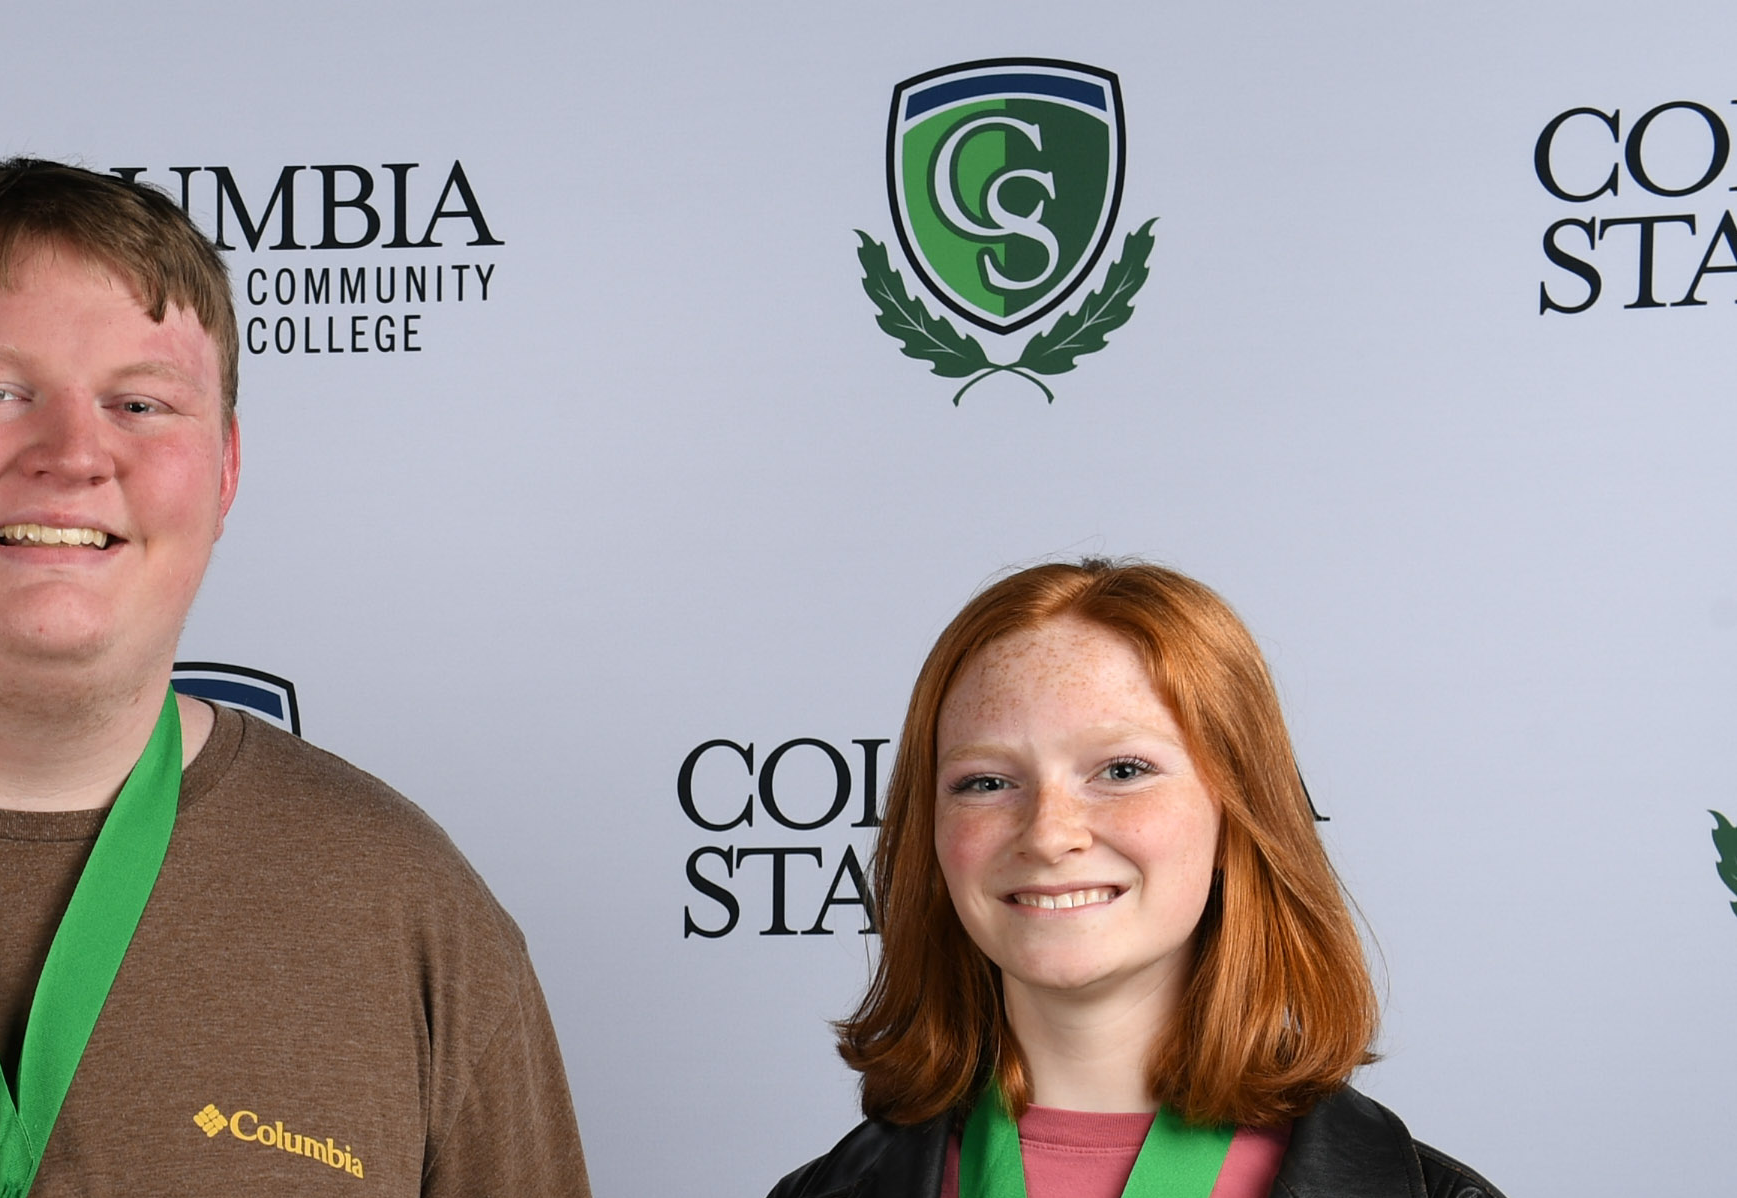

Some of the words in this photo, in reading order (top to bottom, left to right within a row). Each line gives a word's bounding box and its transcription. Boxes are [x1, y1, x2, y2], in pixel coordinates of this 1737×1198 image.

[246, 263, 497, 306] COMMUNITY
[246, 314, 424, 355] COLLEGE
[229, 1109, 365, 1180] Columbia
